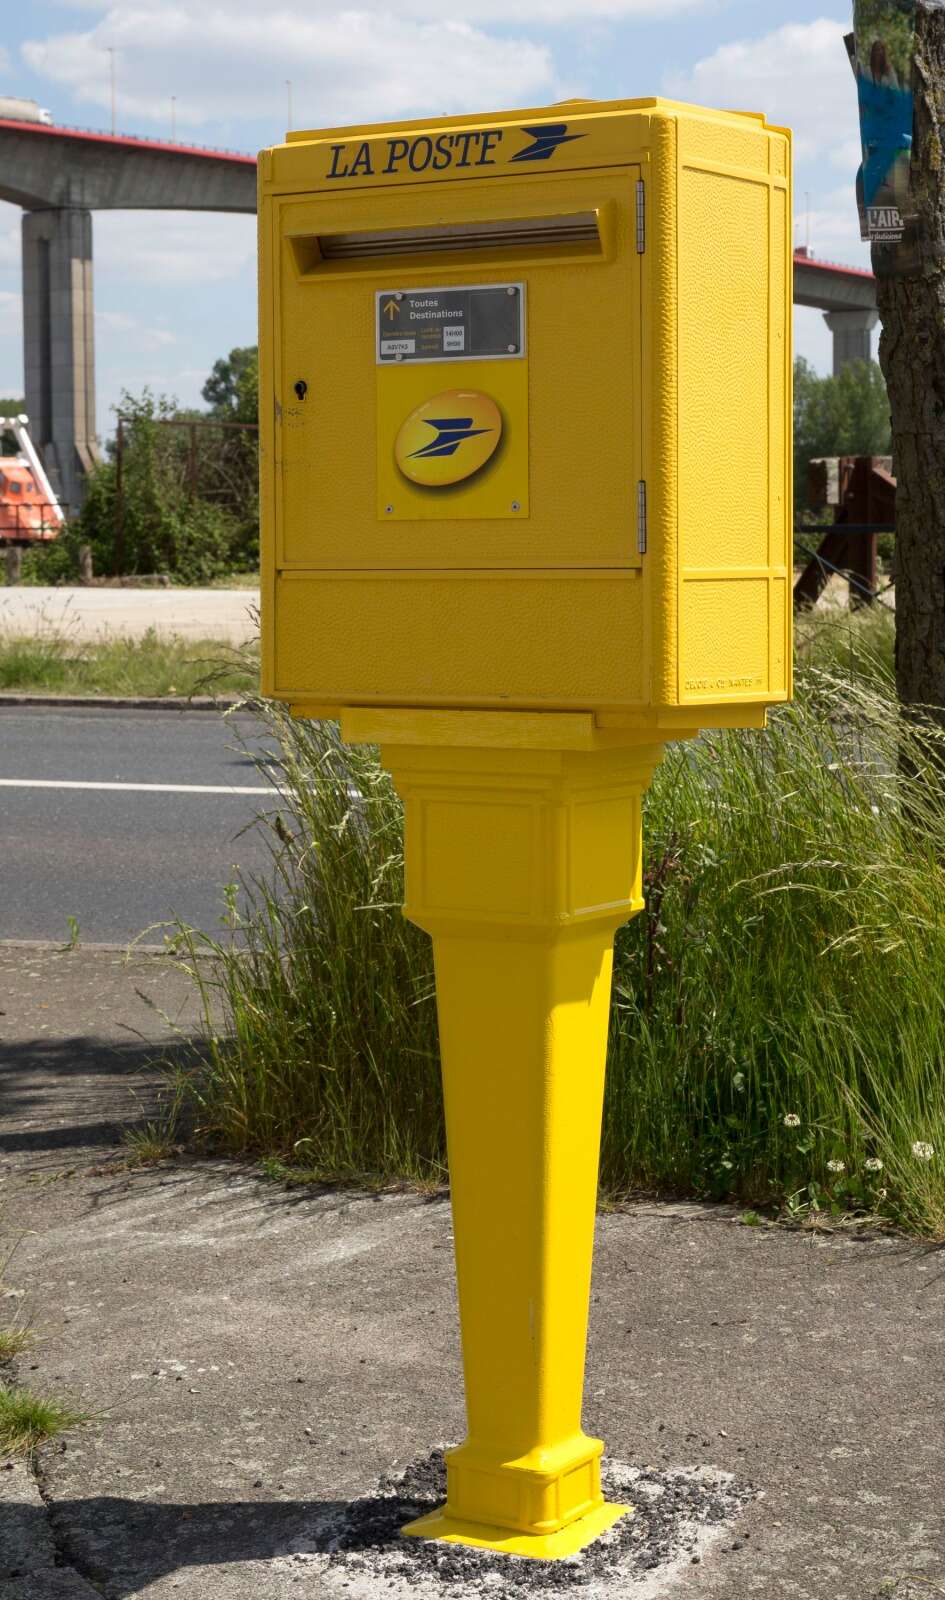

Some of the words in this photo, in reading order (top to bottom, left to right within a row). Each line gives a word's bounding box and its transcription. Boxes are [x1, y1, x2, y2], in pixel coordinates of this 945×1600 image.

[325, 142, 375, 179] LA
[382, 130, 503, 174] POSTE
[409, 299, 439, 308] Toutes
[409, 309, 464, 320] Destinations
